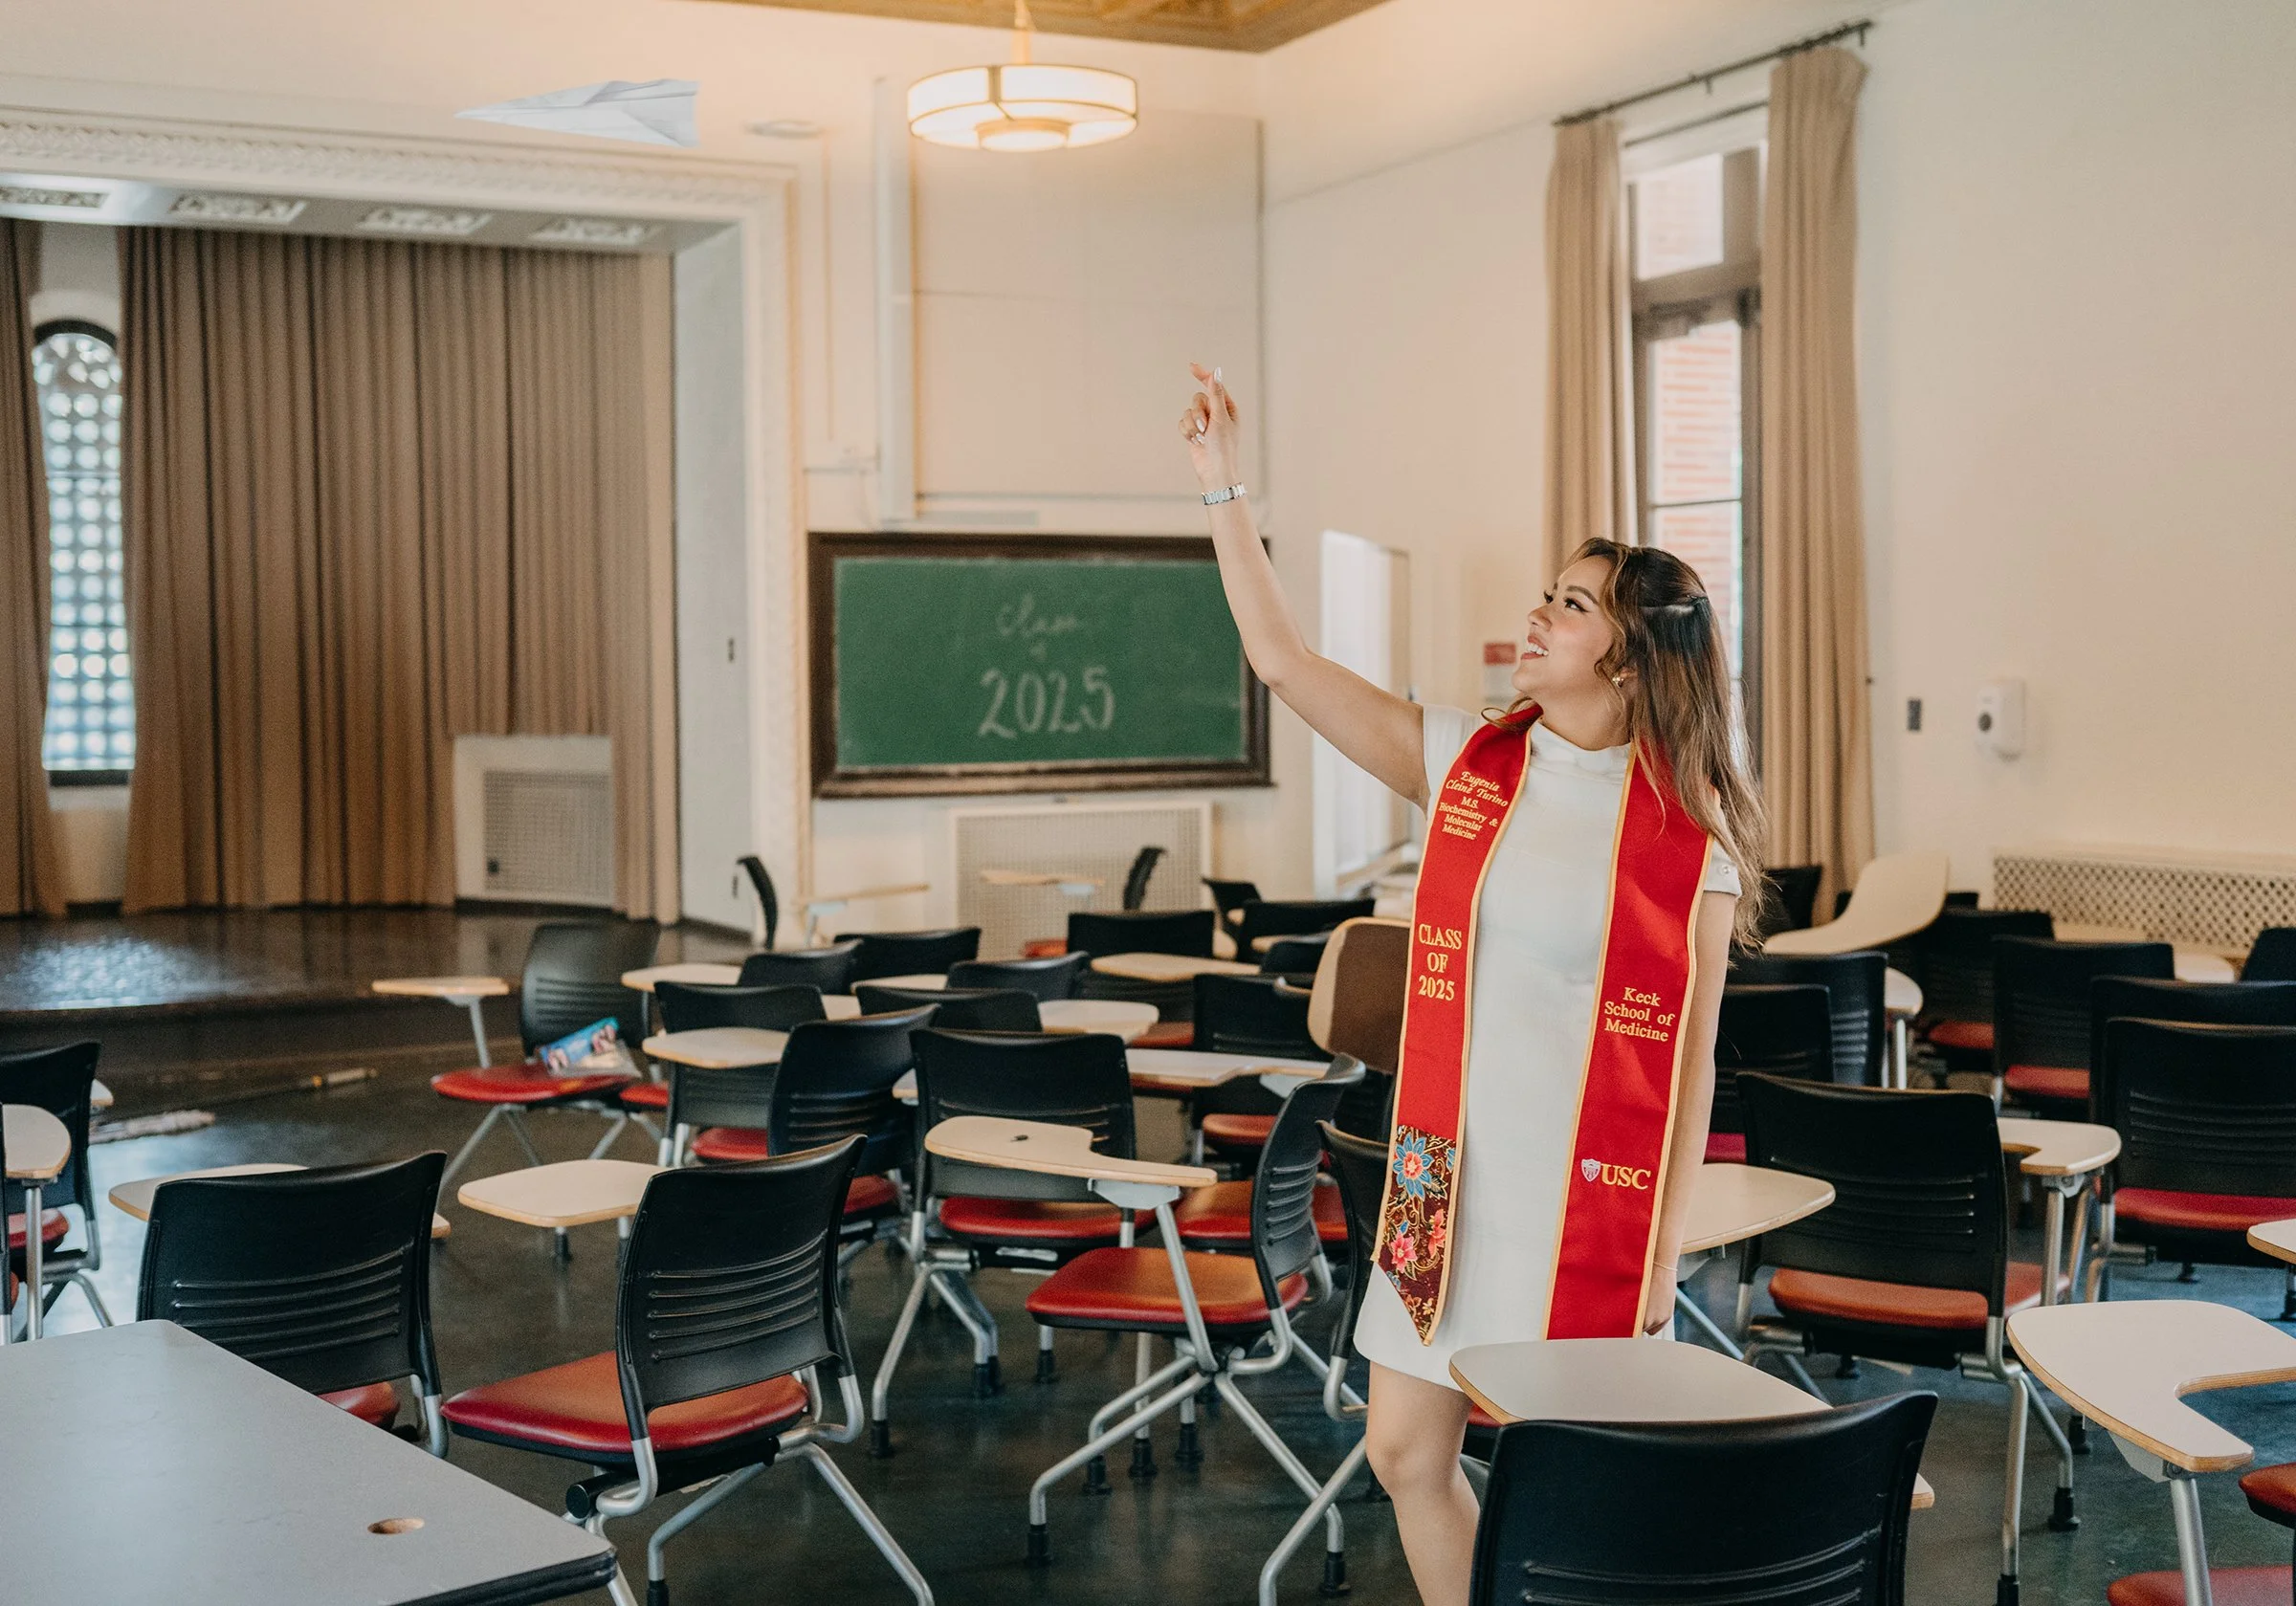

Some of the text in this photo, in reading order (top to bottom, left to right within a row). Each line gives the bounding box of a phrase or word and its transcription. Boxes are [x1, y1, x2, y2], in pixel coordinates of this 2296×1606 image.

[979, 665, 1116, 739] 2025
[1460, 771, 1500, 791] Eugenia
[1476, 788, 1509, 807] Turino
[1438, 802, 1499, 827] Biochemistry &
[1444, 813, 1483, 832] Molecular
[1442, 824, 1477, 841] Medicine
[1419, 923, 1462, 950] CLASS
[1426, 952, 1448, 973] OF
[1418, 975, 1455, 1001] 2025
[1623, 987, 1662, 1007] Keck
[1604, 1001, 1676, 1026] School of
[1604, 1017, 1668, 1042] Medicine
[1601, 1163, 1651, 1190] USC
